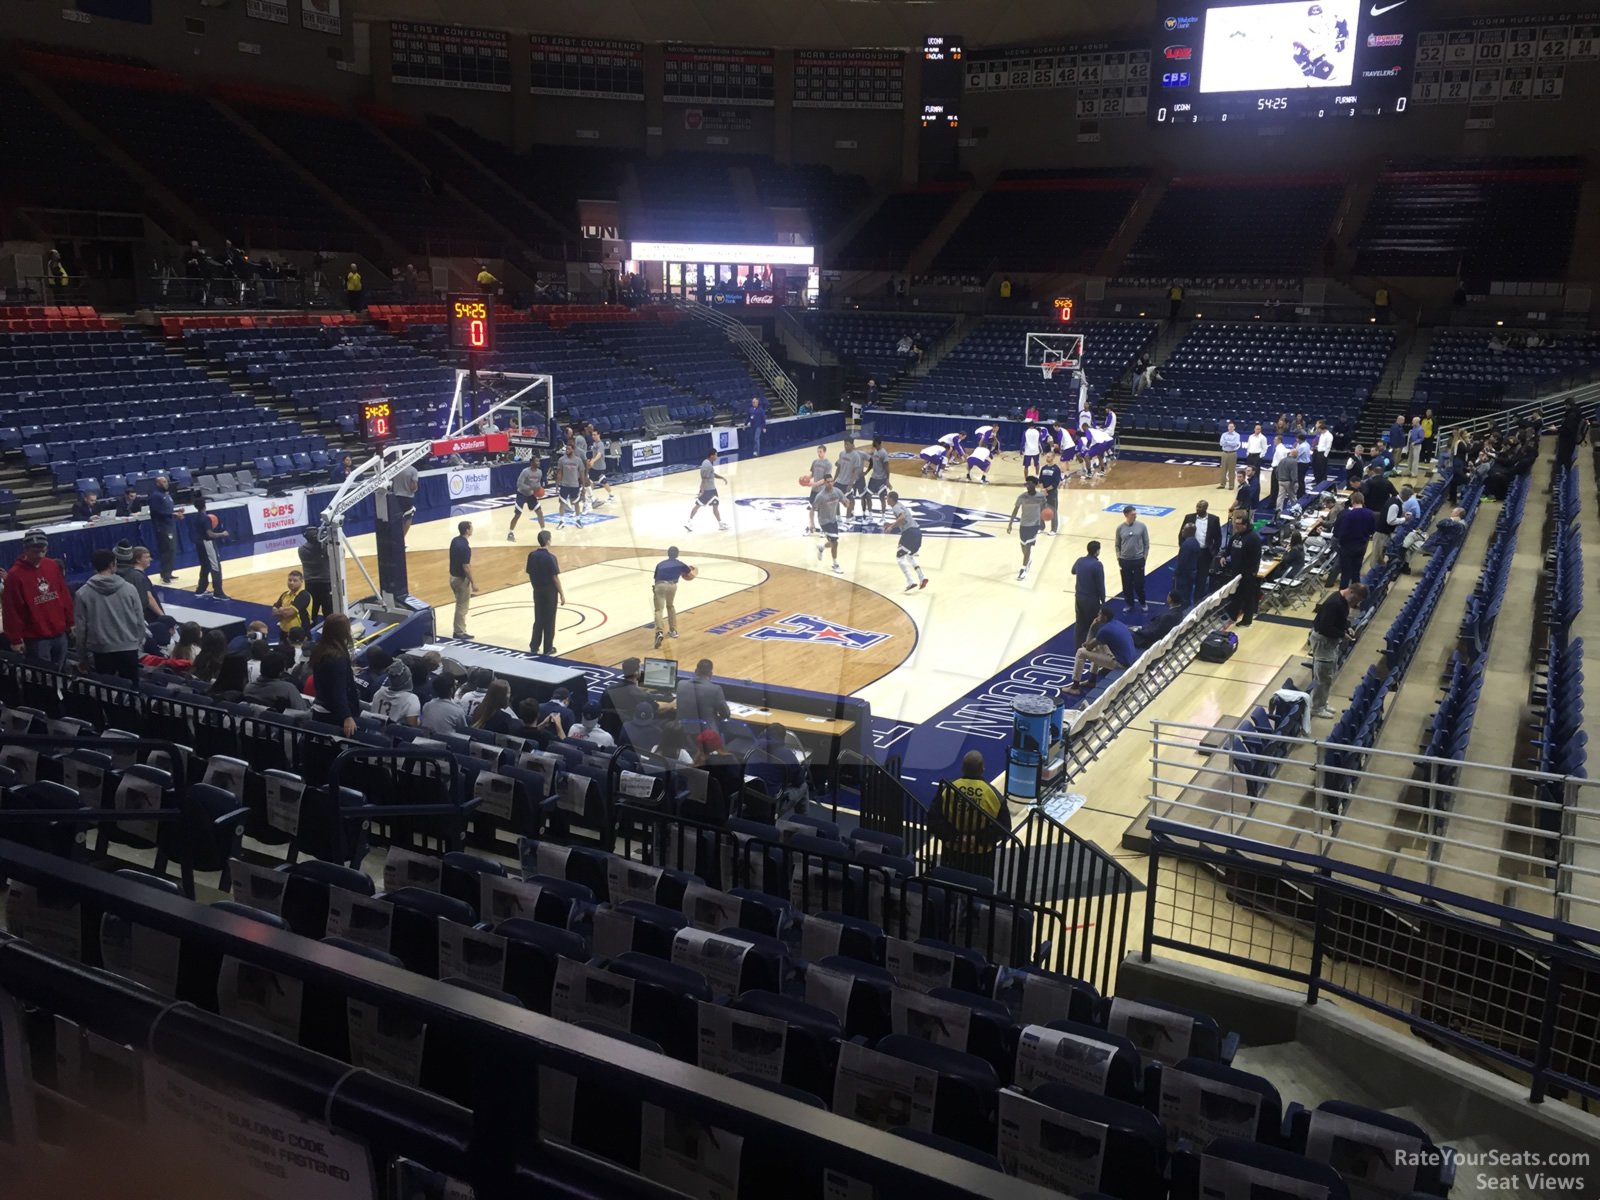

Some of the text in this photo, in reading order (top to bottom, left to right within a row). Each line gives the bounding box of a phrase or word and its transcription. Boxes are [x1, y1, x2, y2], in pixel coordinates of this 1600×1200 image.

[1511, 15, 1554, 24] HUSKIES
[392, 23, 507, 40] BIG EAST CONFERENCE
[552, 37, 576, 46] EAST
[581, 39, 641, 50] CONFERENCE
[927, 37, 944, 45] UCONN
[1578, 40, 1592, 55] 34
[1420, 47, 1440, 61] 52
[1480, 44, 1502, 58] 00
[1512, 43, 1531, 57] 13
[1543, 41, 1565, 56] 42
[800, 51, 899, 60] NCAA CHAMPIONSHIP
[1035, 71, 1051, 83] 25
[1058, 69, 1075, 81] 42
[1081, 68, 1099, 80] 44
[1130, 65, 1148, 77] 42
[994, 73, 1001, 85] 9
[1012, 72, 1028, 84] 22
[1420, 84, 1431, 97] 15
[1448, 83, 1462, 97] 22
[1509, 80, 1524, 95] 42
[1542, 79, 1555, 94] 13
[1103, 100, 1120, 112] 22
[1257, 97, 1288, 111] 54:25
[1335, 95, 1358, 104] FURMAN
[1396, 97, 1407, 112] 0
[1081, 101, 1094, 113] 13
[1173, 103, 1191, 112] UCONN
[1318, 109, 1324, 118] 0
[1349, 108, 1355, 117] 3
[1157, 107, 1167, 122] 0
[1192, 115, 1198, 123] 3
[1221, 113, 1227, 122] 0
[1054, 299, 1073, 308] 54:25
[454, 302, 487, 319] 54:25
[1062, 307, 1071, 321] 0
[471, 320, 484, 346] 0
[364, 404, 390, 420] 54:25
[377, 418, 386, 434] 0
[465, 473, 489, 483] Webster
[263, 503, 295, 518] BOB'S
[264, 518, 295, 529] FURNITURE
[959, 785, 983, 798] CSC
[226, 1111, 285, 1144] BUILDING
[279, 1147, 350, 1182] FASTENED
